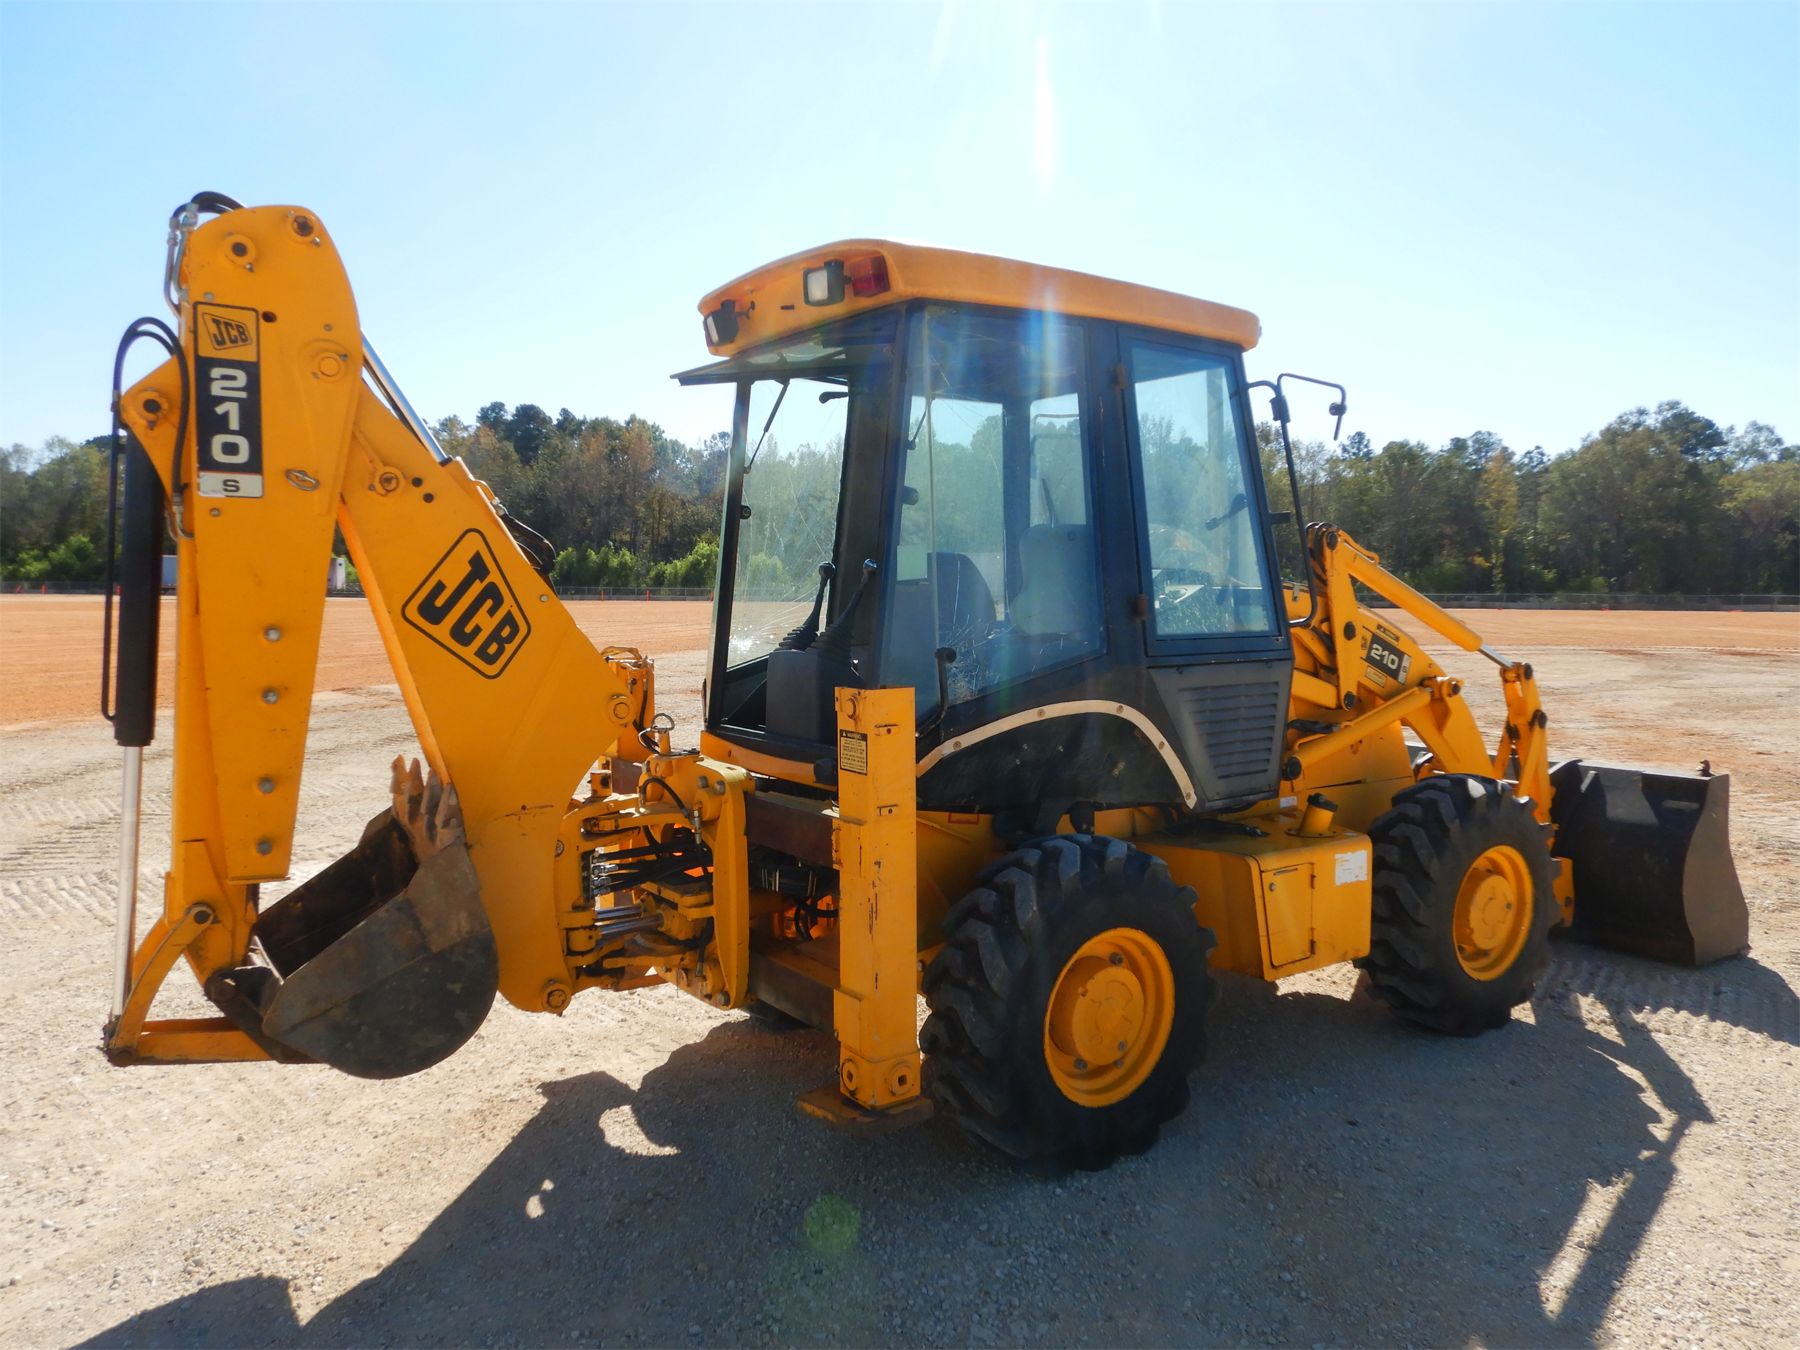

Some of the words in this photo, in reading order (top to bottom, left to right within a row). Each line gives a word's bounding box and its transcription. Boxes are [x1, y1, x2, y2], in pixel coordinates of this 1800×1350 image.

[211, 317, 250, 346] JCB
[210, 367, 250, 464] 210
[222, 479, 240, 493] S
[417, 550, 520, 666] JCB
[1370, 643, 1399, 670] 210
